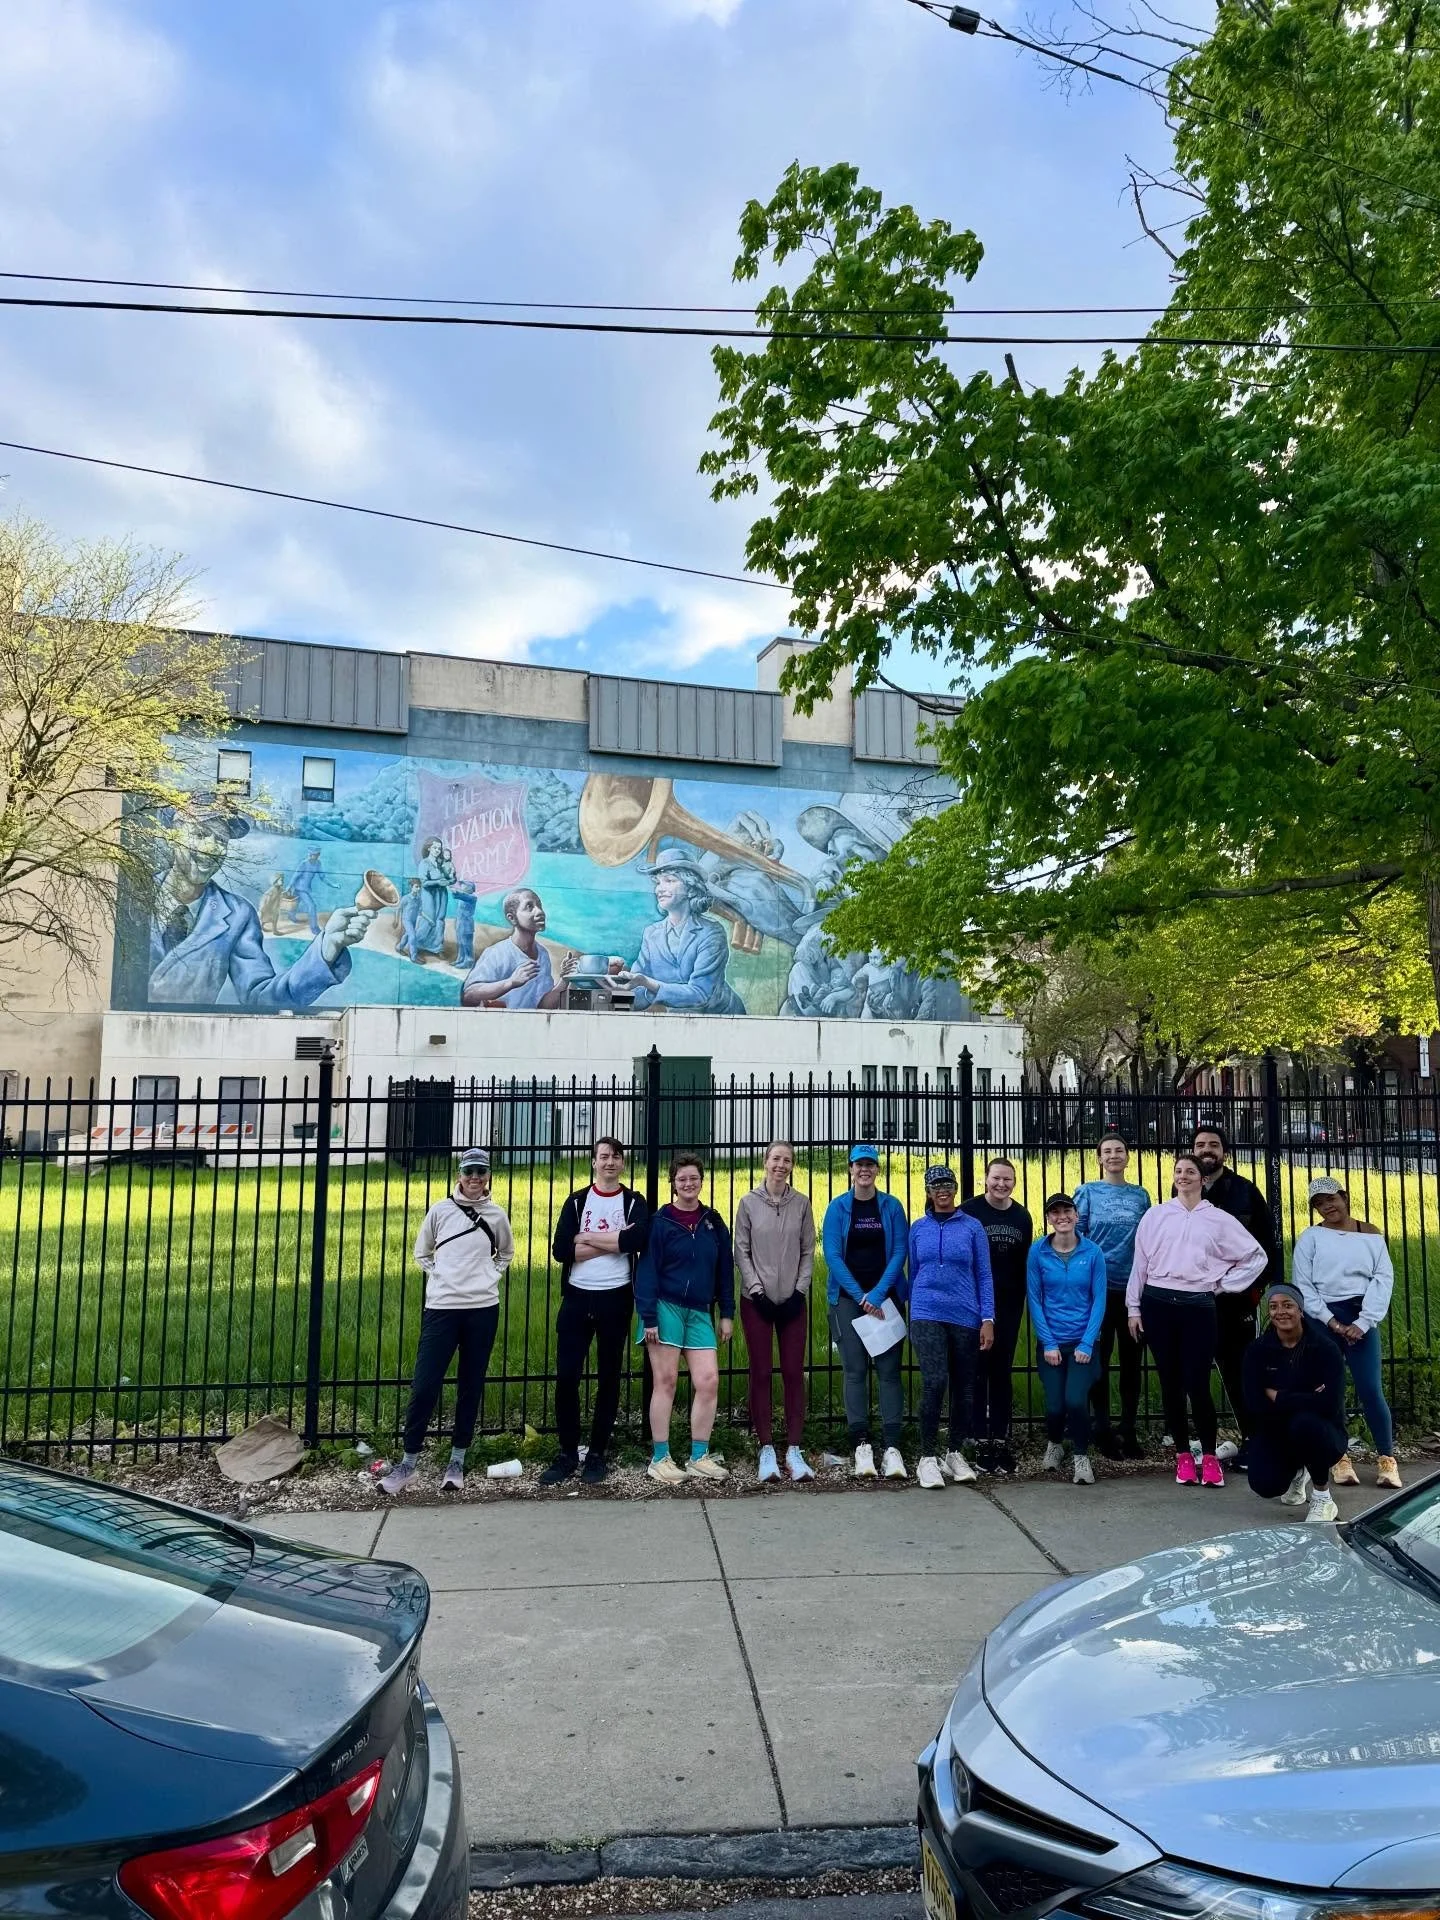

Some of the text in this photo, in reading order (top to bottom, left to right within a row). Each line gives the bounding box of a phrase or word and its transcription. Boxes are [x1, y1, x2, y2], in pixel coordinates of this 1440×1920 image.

[442, 799, 515, 850] ALVATION
[445, 787, 481, 820] THE
[460, 833, 515, 880] ARMY
[331, 1733, 370, 1777] MALIBU
